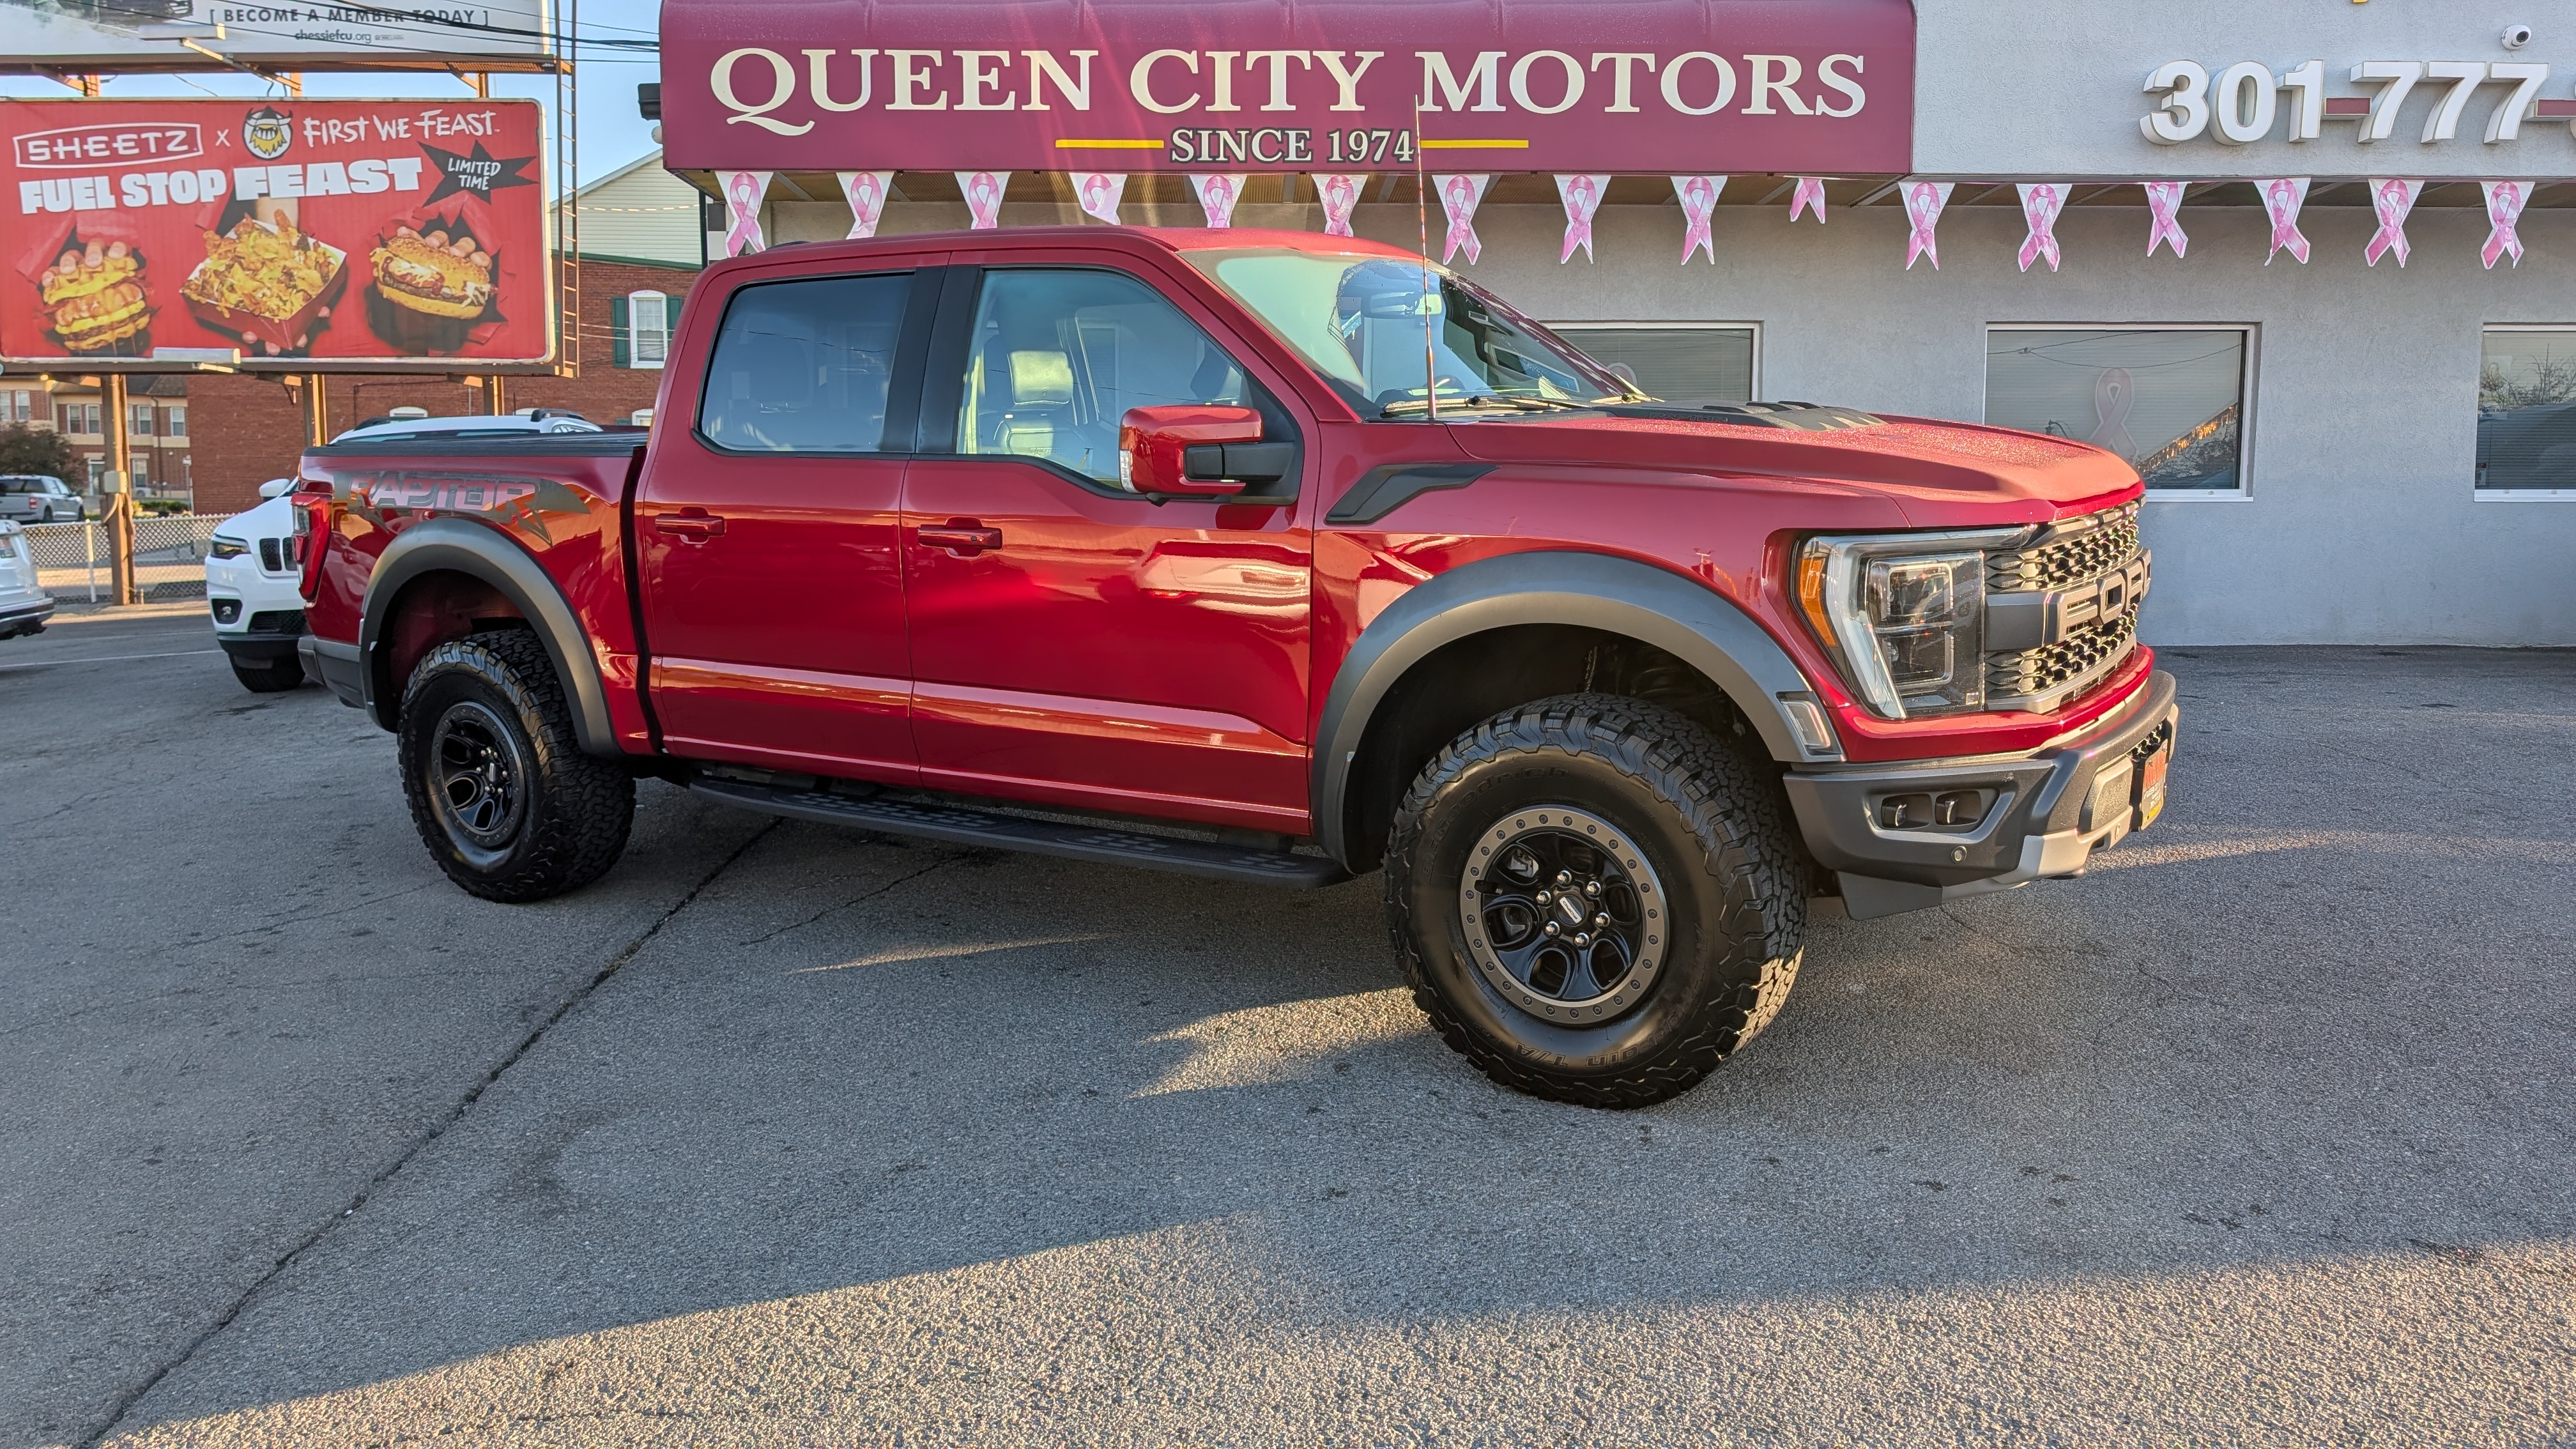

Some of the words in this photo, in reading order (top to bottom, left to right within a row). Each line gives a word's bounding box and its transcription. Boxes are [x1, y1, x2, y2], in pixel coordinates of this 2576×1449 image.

[224, 9, 298, 22] BECOME
[307, 8, 319, 22] A
[295, 29, 371, 44] chessiefcu.org
[710, 48, 1099, 136] QUEEN
[1130, 50, 1384, 114] CITY
[1415, 50, 1866, 118] MOTORS
[2140, 59, 2576, 146] 301-777-
[27, 130, 189, 161] SHEETZ
[303, 116, 370, 148] FIRST
[372, 114, 412, 141] WE
[1170, 127, 1314, 164] SINCE
[1326, 128, 1416, 164] 1974
[447, 157, 501, 177] LIMITED
[458, 174, 489, 191] TIME
[19, 175, 117, 214] FUEL
[120, 168, 227, 207] STOP
[233, 157, 423, 201] FEAST
[349, 476, 538, 514] RAPTOR
